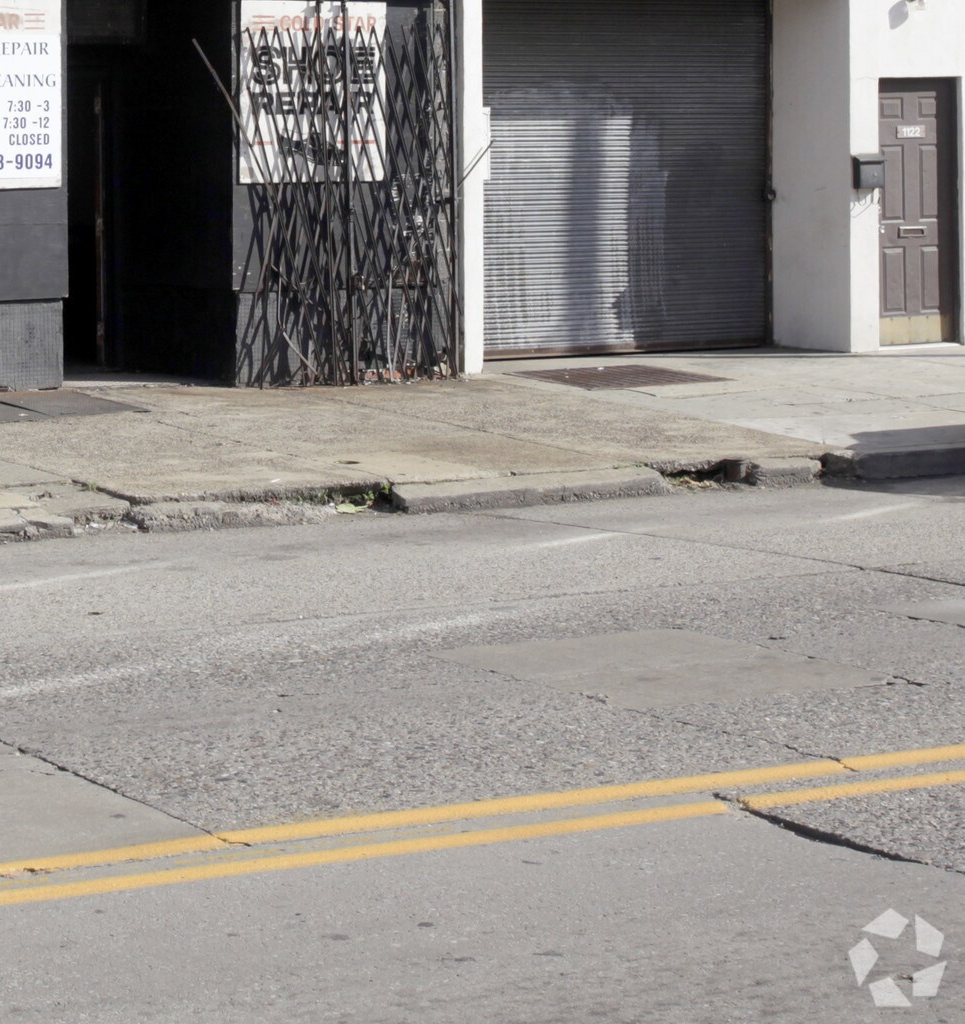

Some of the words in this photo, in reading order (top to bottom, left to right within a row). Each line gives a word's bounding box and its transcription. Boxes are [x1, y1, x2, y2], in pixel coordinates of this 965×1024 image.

[280, 16, 325, 32] GOLD
[333, 16, 377, 32] STAR
[252, 45, 375, 85] SHOE
[8, 100, 31, 112] 7:30
[3, 117, 27, 129] 7:30
[902, 127, 920, 137] 1122
[8, 133, 50, 146] CLOSED
